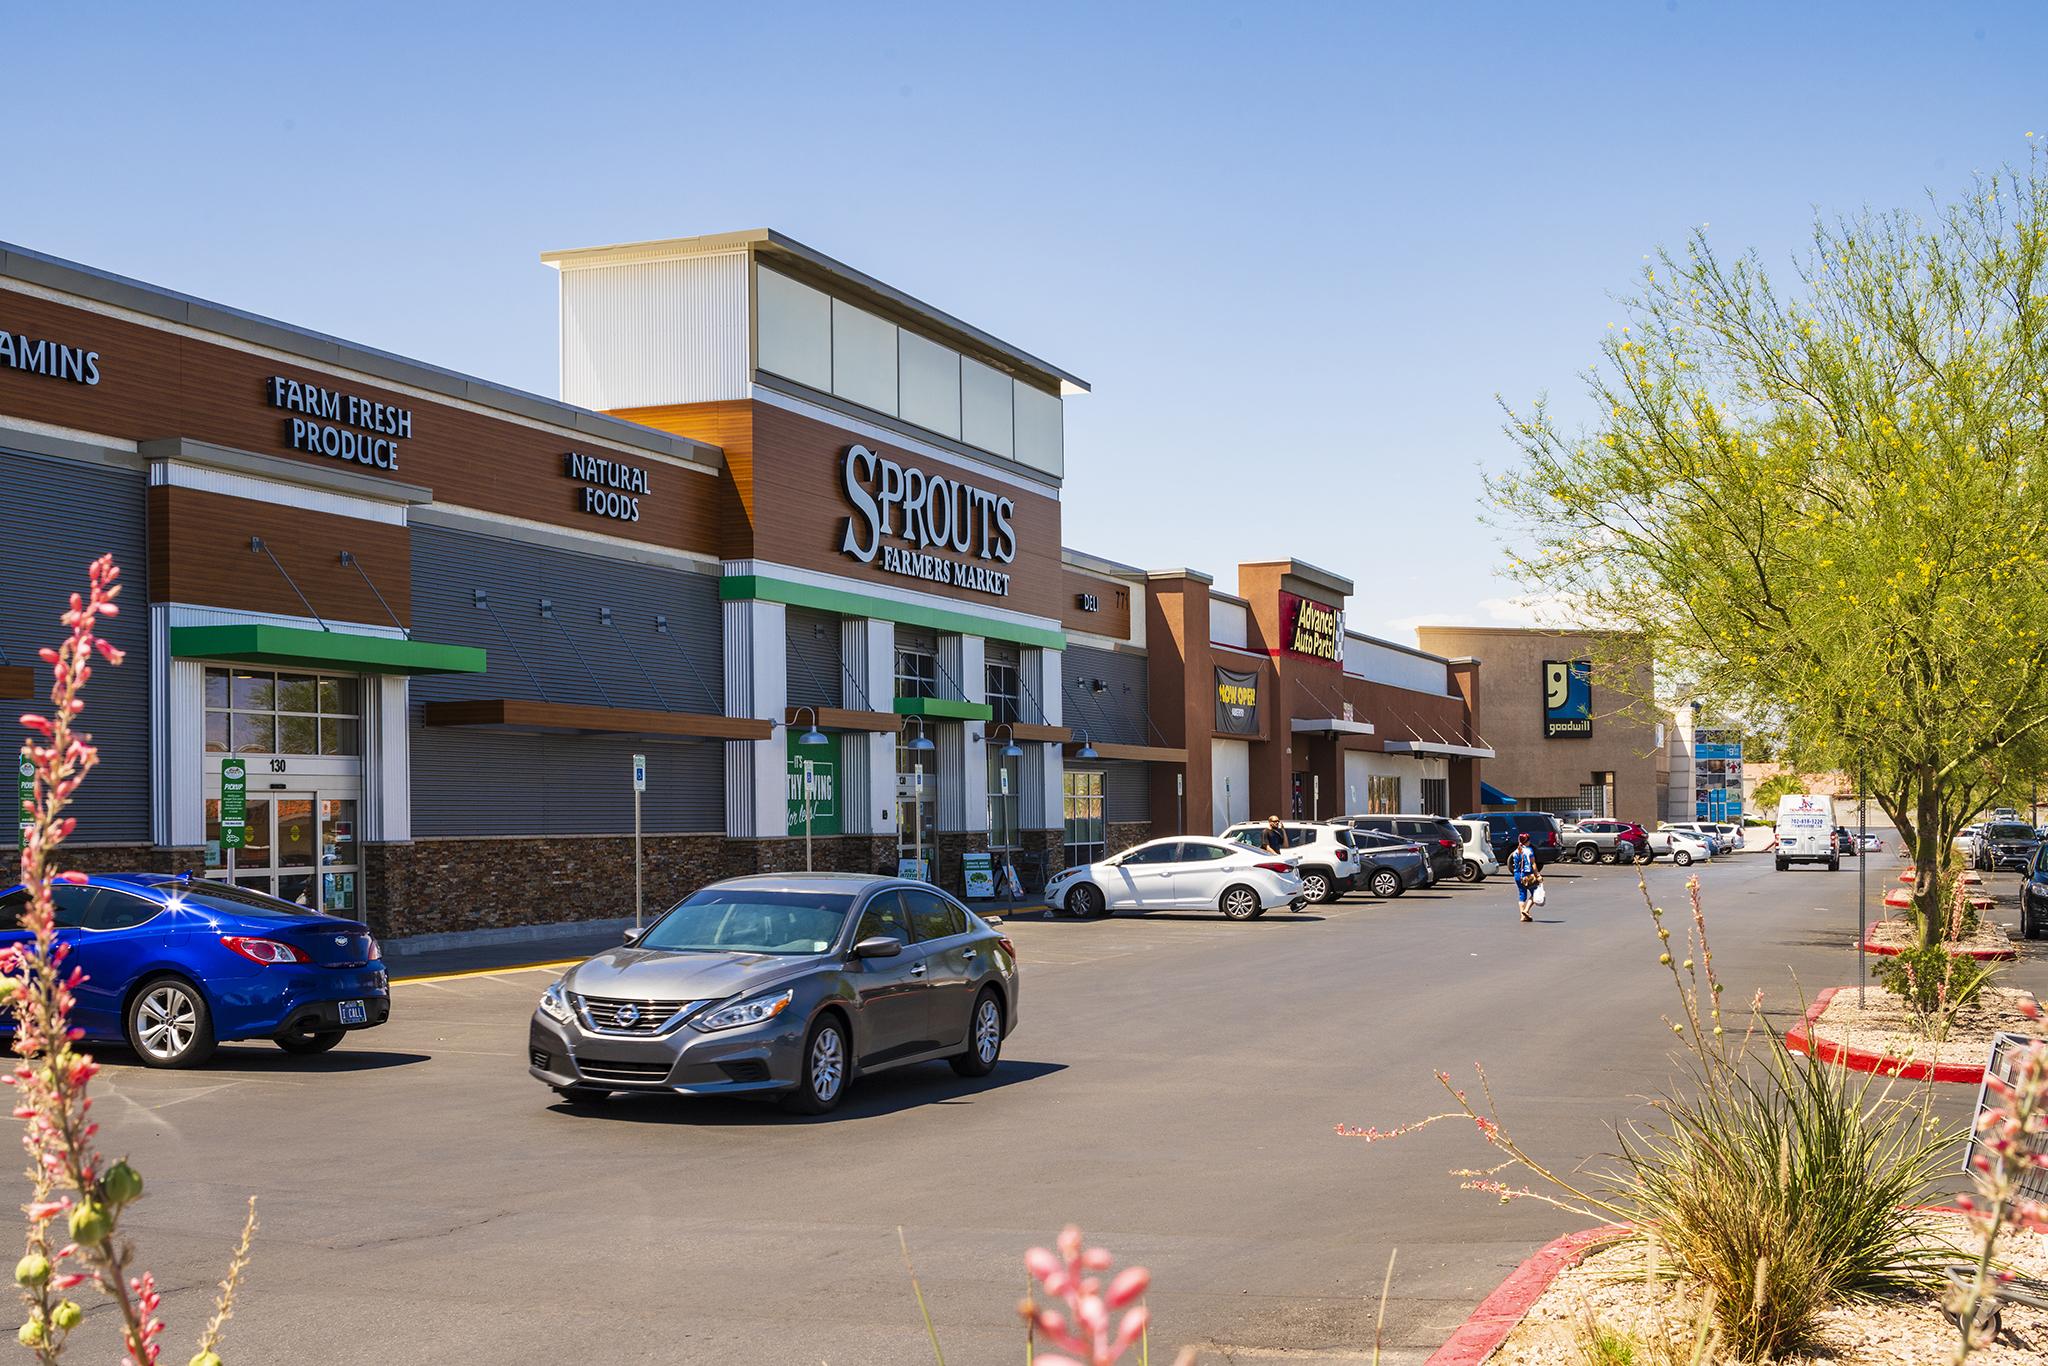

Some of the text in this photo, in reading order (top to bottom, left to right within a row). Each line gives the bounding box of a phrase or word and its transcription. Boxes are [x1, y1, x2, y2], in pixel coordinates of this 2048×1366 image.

[0, 330, 100, 385] AMINS
[274, 376, 413, 439] FARM FRESH
[292, 418, 399, 471] PRODUCE
[572, 452, 652, 495] NATURAL
[585, 487, 640, 522] FOODS
[842, 444, 1017, 564] SPROUTS
[883, 545, 1011, 597] FARMERS MARKET
[1084, 593, 1099, 612] DELI
[1297, 599, 1334, 636] Advance
[1293, 627, 1333, 659] Auto Parts
[1218, 684, 1237, 705] NOW
[1549, 720, 1590, 736] goodwill
[270, 759, 286, 773] 130
[224, 783, 244, 791] PICKUP
[348, 1007, 364, 1019] CALL
